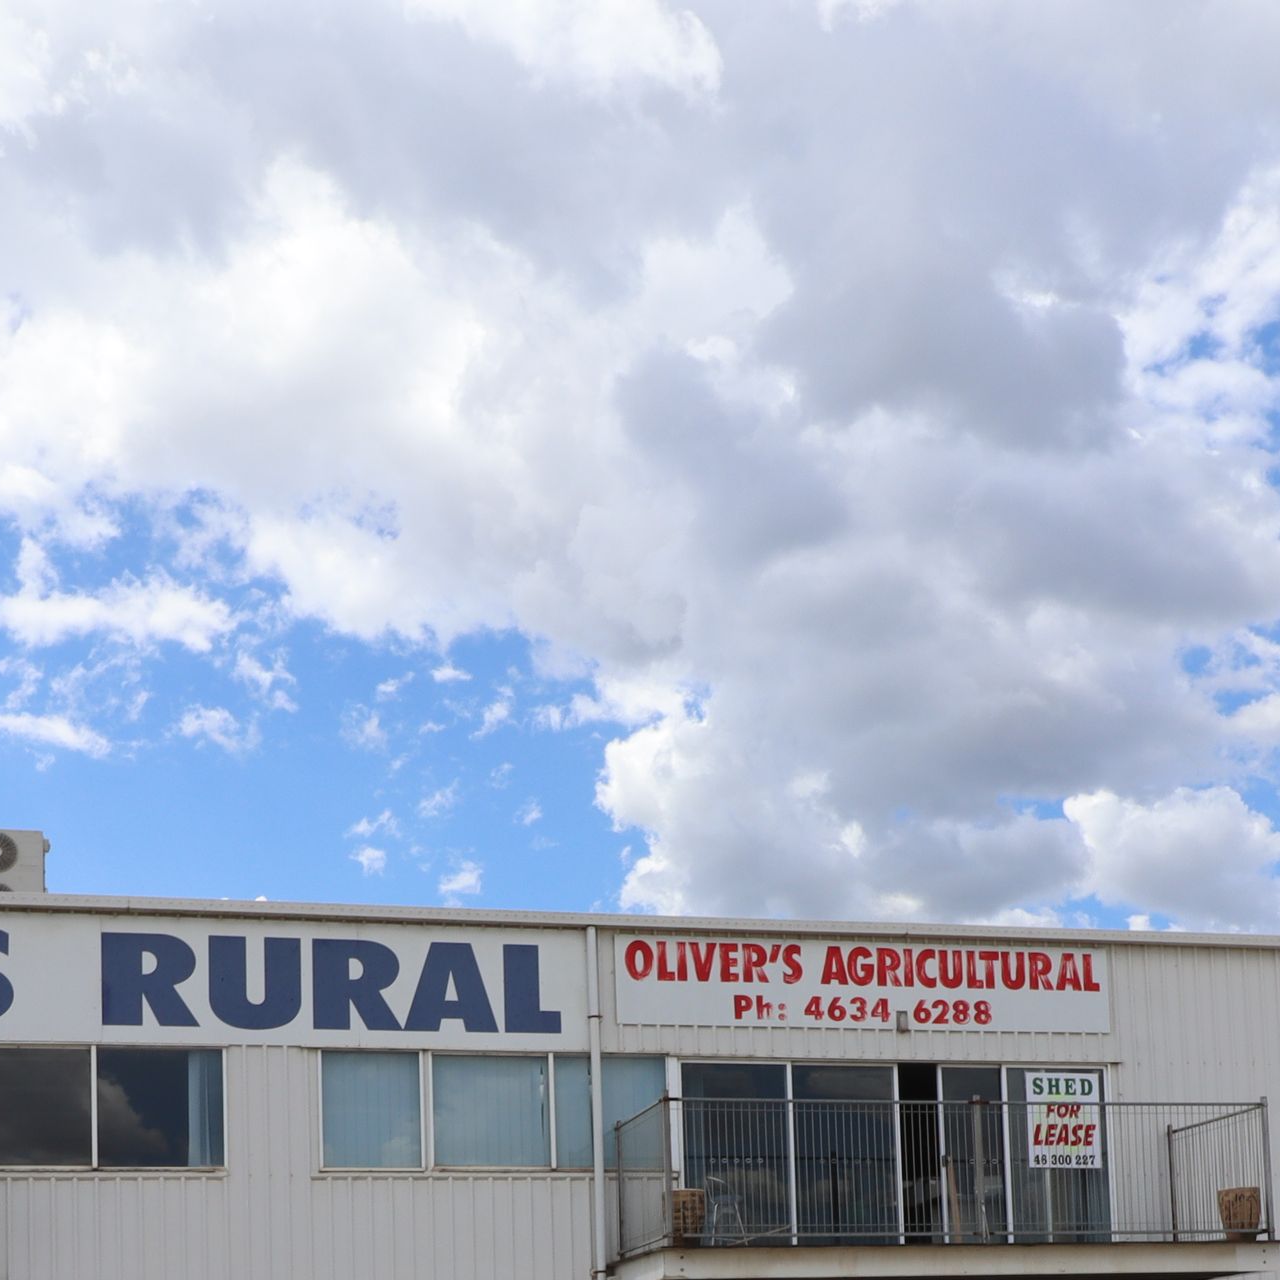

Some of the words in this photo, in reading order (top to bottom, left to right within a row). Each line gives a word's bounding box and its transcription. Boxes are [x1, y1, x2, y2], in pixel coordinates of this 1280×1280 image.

[624, 939, 802, 985] OLIVER'S
[821, 945, 1101, 992] AGRICULTURAL
[101, 932, 562, 1034] RURAL
[733, 994, 787, 1021] Ph:
[803, 996, 891, 1023] 4634
[913, 1000, 993, 1026] 6288
[1032, 1077, 1093, 1096] SHED
[1046, 1102, 1081, 1118] FOR
[1033, 1123, 1096, 1146] LEASE
[1051, 1154, 1072, 1165] 300
[1075, 1154, 1095, 1165] 227
